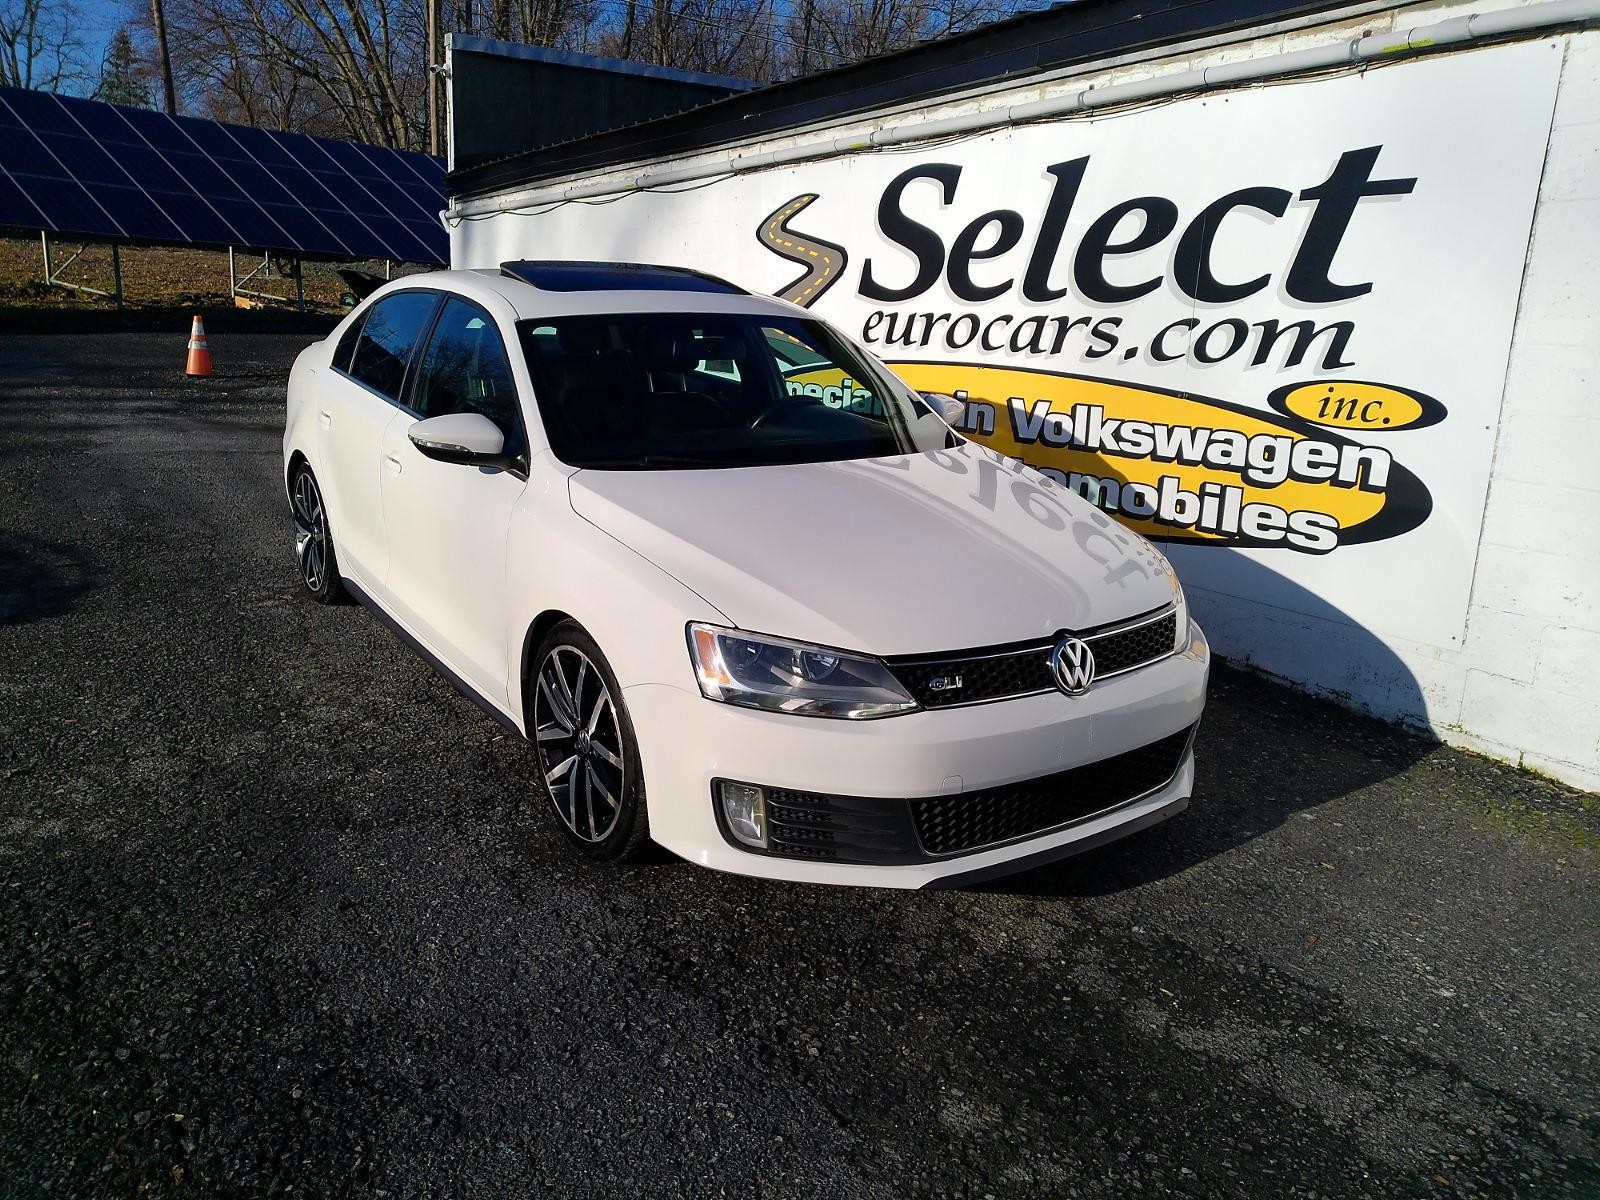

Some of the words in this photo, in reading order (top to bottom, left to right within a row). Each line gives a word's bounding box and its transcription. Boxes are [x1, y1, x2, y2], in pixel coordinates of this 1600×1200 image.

[858, 145, 1418, 303] Select
[862, 310, 1355, 370] eurocars.com
[1318, 382, 1391, 425] inc.
[1006, 397, 1394, 493] Volkswagen
